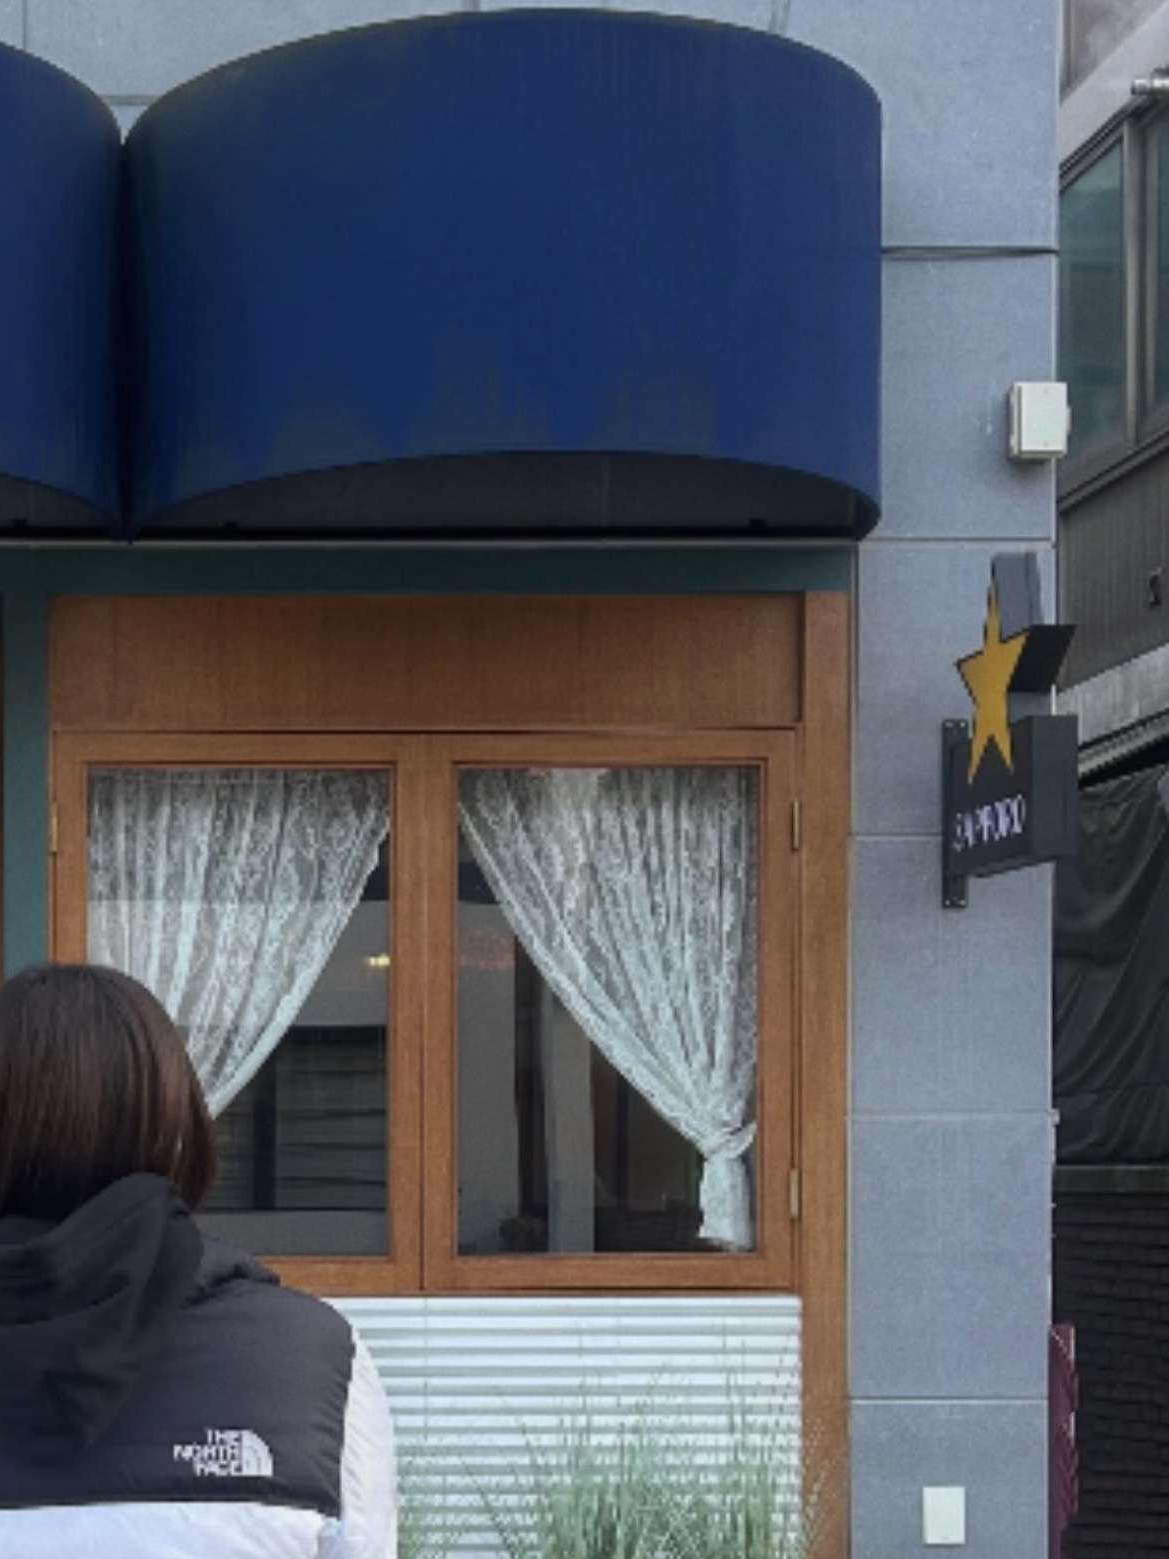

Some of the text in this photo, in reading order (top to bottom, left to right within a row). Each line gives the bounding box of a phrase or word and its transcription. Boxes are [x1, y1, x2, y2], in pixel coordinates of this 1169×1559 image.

[206, 1429, 241, 1444] THE
[172, 1444, 240, 1461] NORTH
[195, 1461, 242, 1477] FACE
